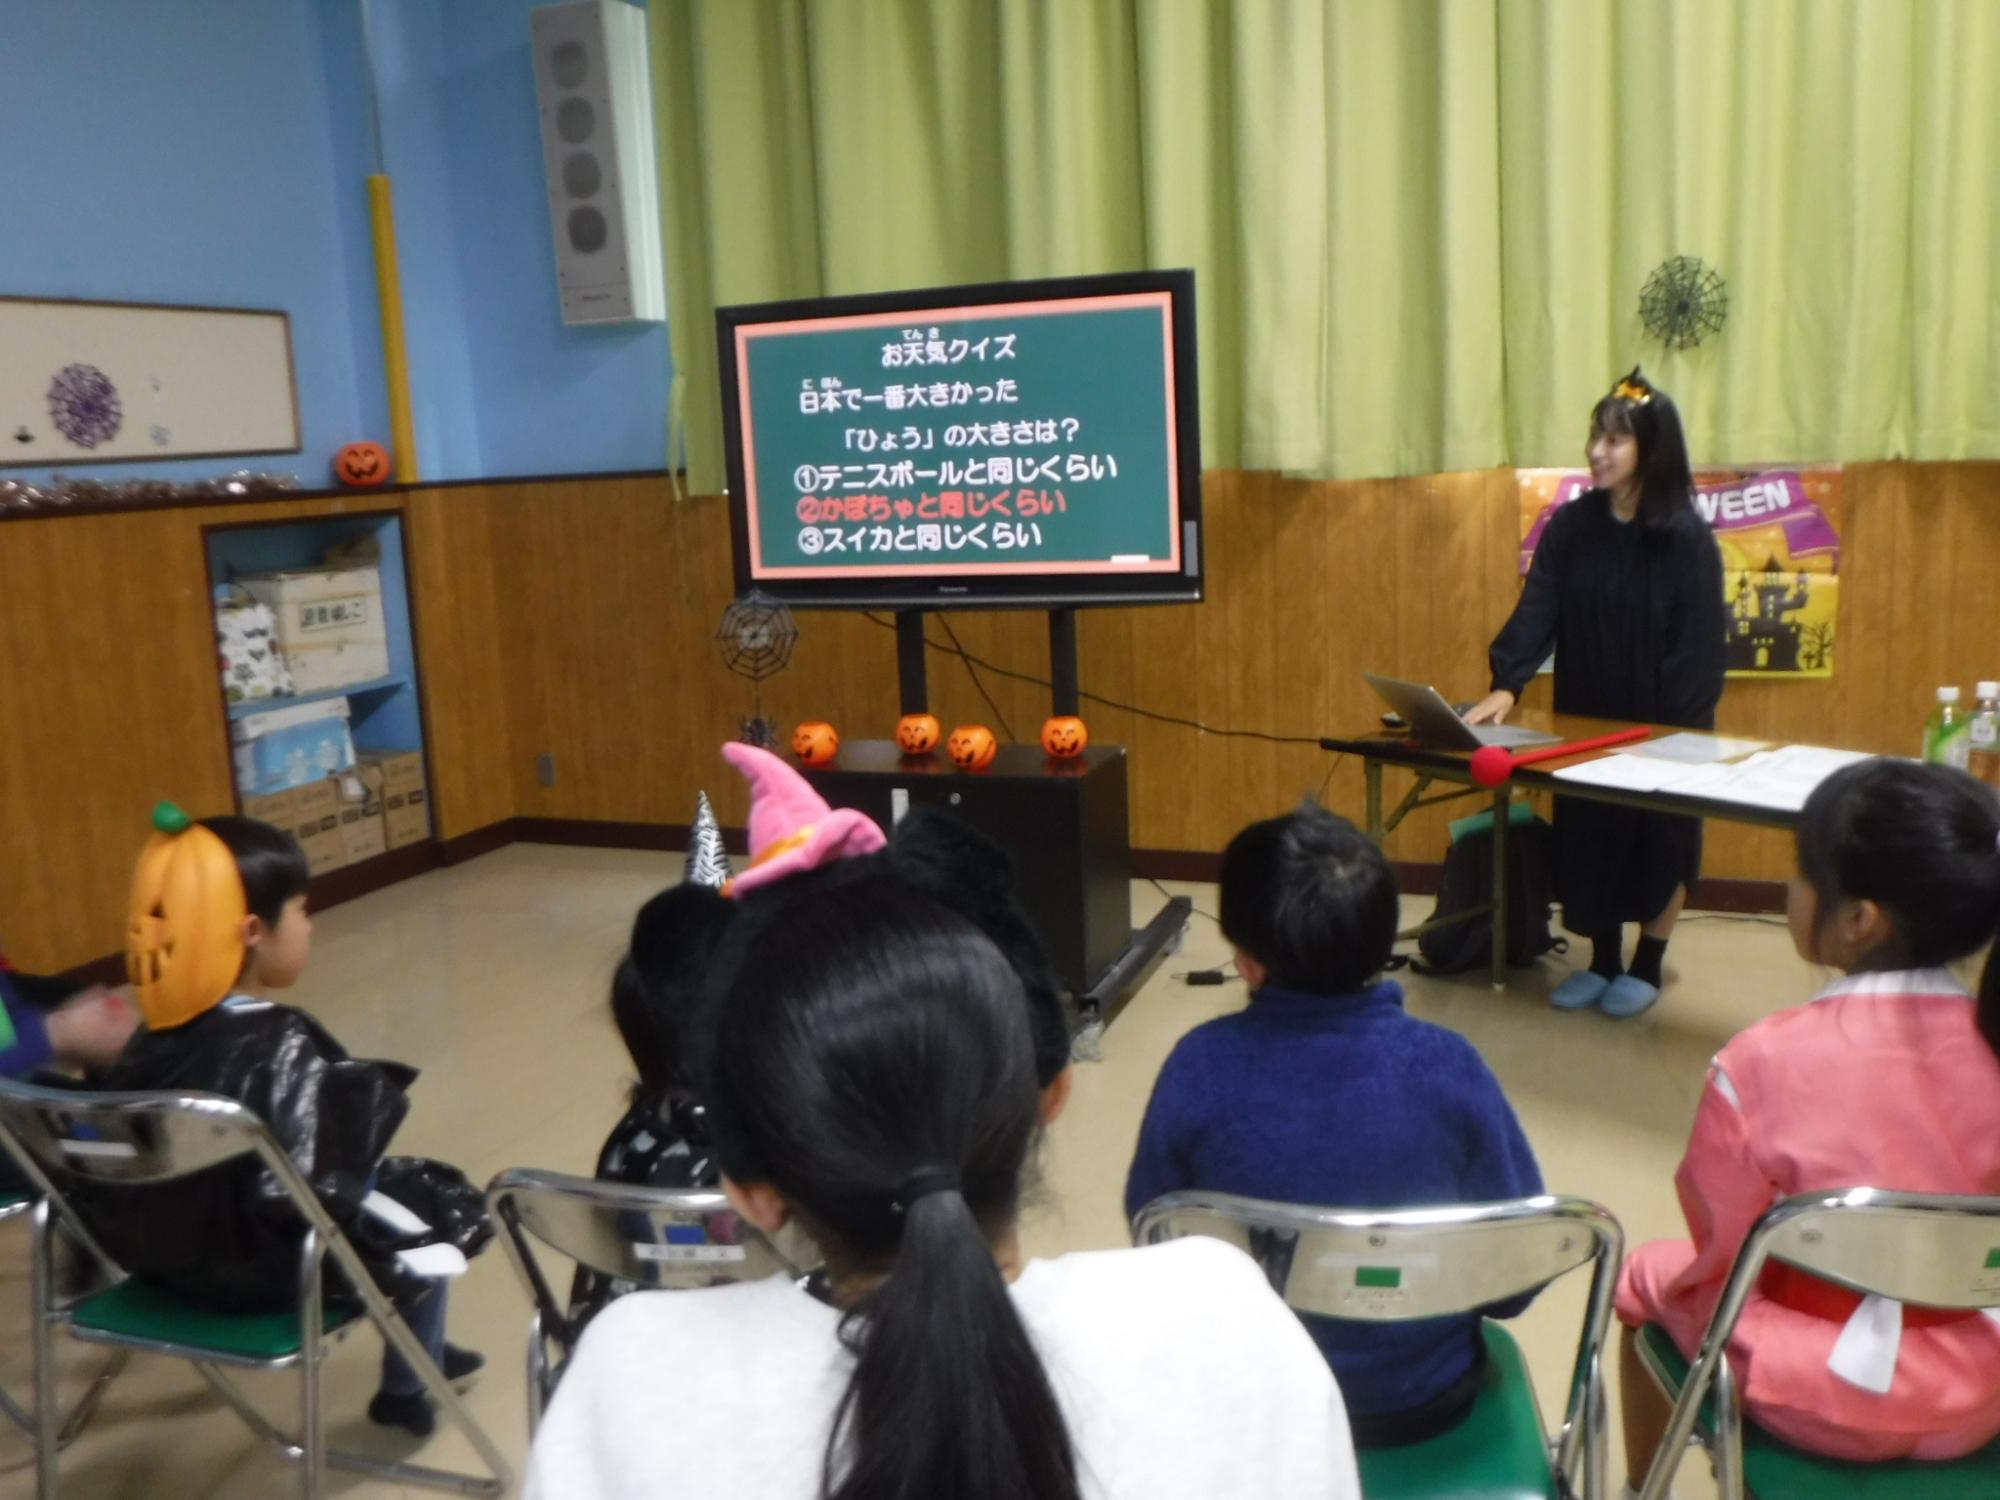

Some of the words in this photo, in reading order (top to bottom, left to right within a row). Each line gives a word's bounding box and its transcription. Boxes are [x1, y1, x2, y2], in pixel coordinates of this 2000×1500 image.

[881, 333, 1017, 367] お天気クイズ
[800, 378, 1018, 414] 日本で一番大きかった
